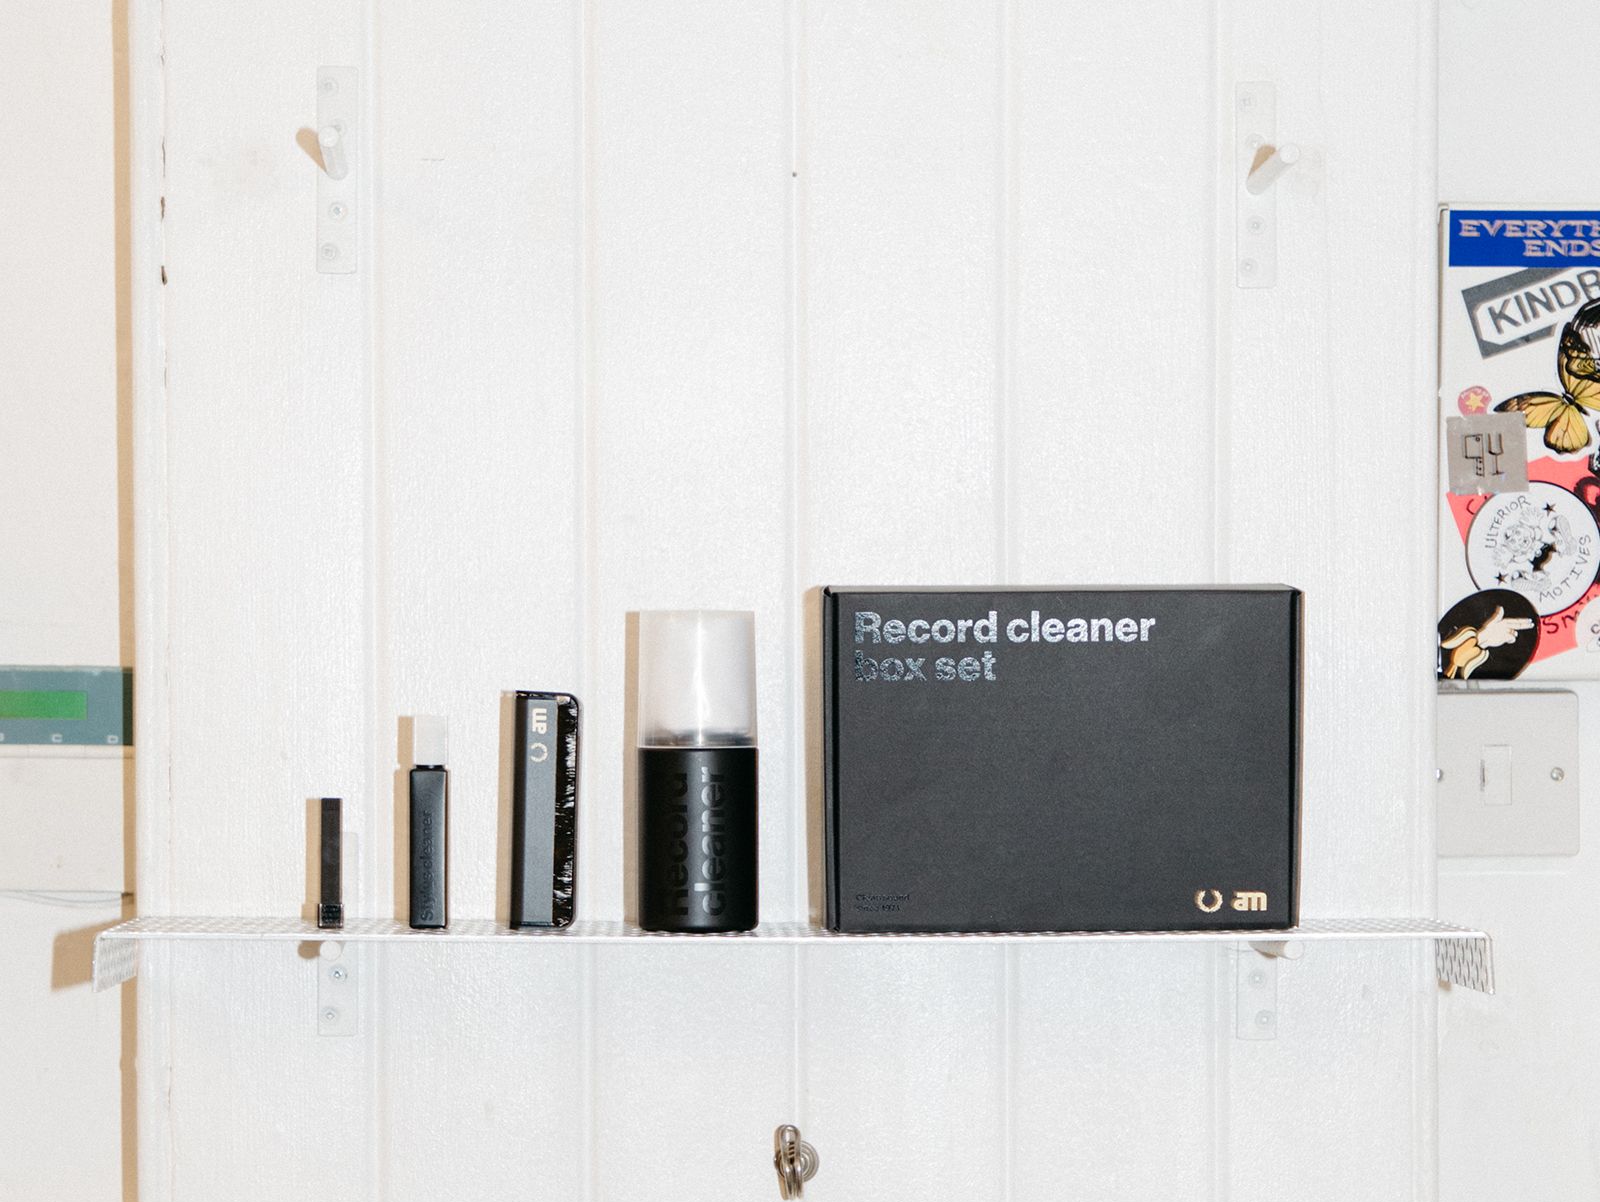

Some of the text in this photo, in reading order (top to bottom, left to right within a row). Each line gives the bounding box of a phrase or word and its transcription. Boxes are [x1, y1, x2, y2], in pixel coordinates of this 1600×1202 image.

[1484, 494, 1532, 549] ULTERIOR
[1539, 533, 1592, 603] MOTIVES
[854, 610, 1156, 644] Record cleaner
[854, 650, 997, 682] box set
[531, 708, 547, 734] am
[694, 766, 726, 916] cleaner
[420, 810, 436, 921] Stylus cleaner
[1232, 891, 1267, 911] am
